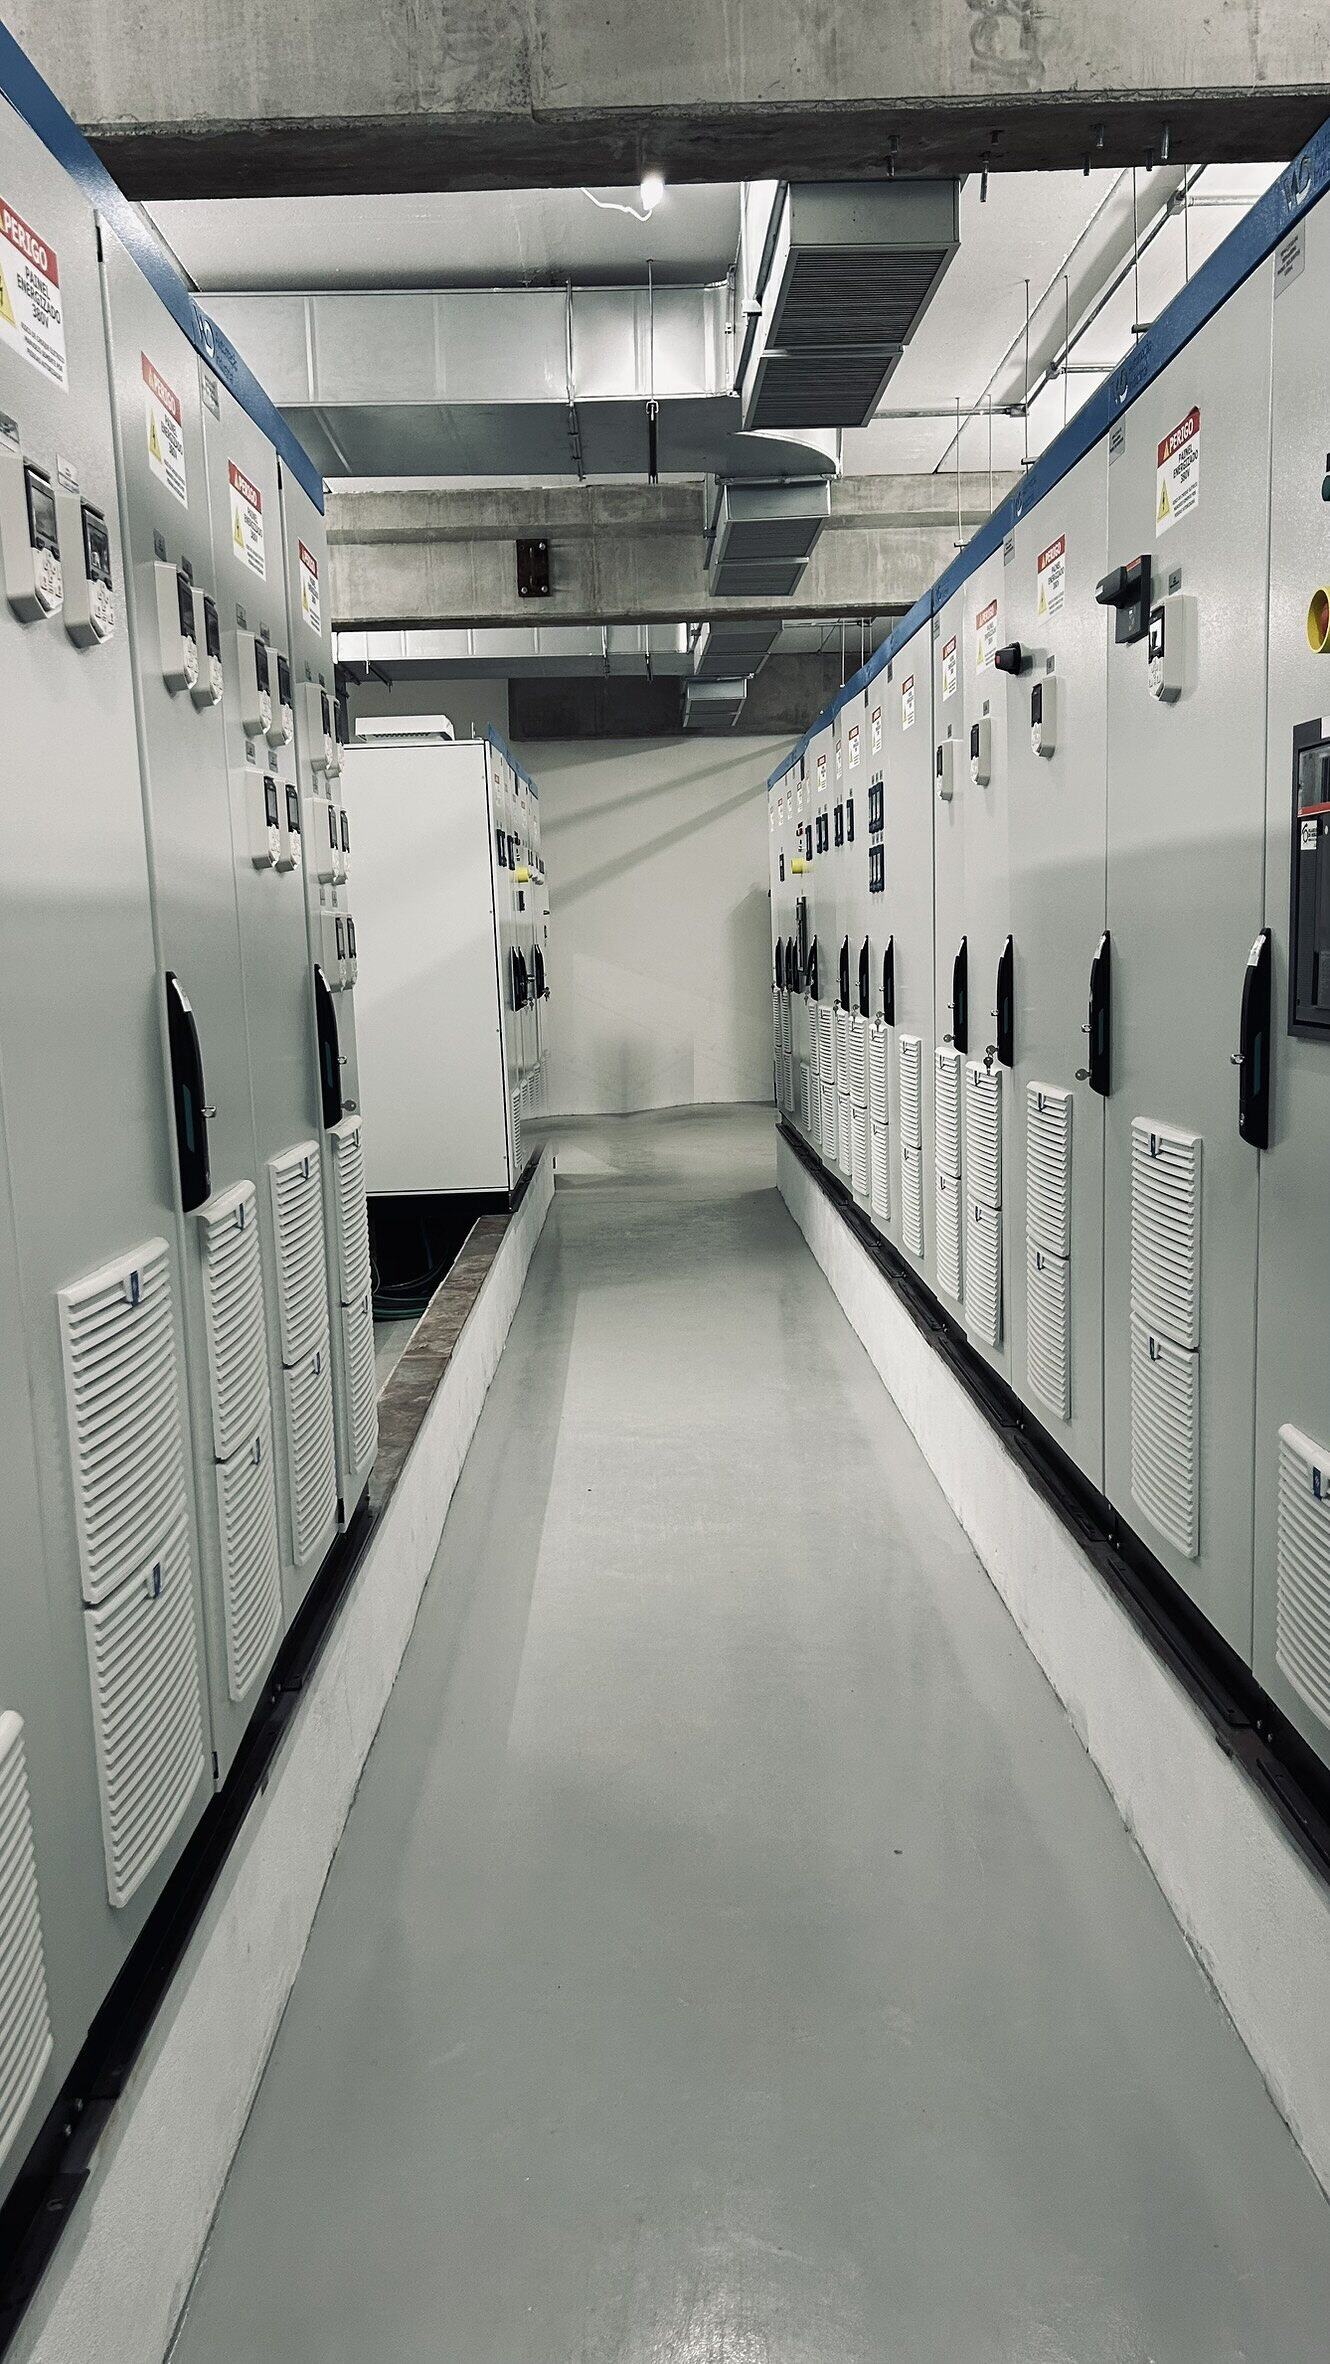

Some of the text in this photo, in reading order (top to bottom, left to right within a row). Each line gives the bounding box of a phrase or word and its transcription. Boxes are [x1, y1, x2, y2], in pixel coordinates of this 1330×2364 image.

[3, 209, 48, 271] PERIGO
[25, 265, 50, 298] PAINEL
[17, 273, 61, 324] ENERGIZADO
[32, 304, 49, 328] 380V
[153, 373, 176, 416] PERIGO
[1169, 418, 1193, 453] PERIGO
[1179, 444, 1193, 460] PAINEL
[1173, 449, 1198, 479] ENERGIZADO
[238, 473, 257, 506] PERIGO
